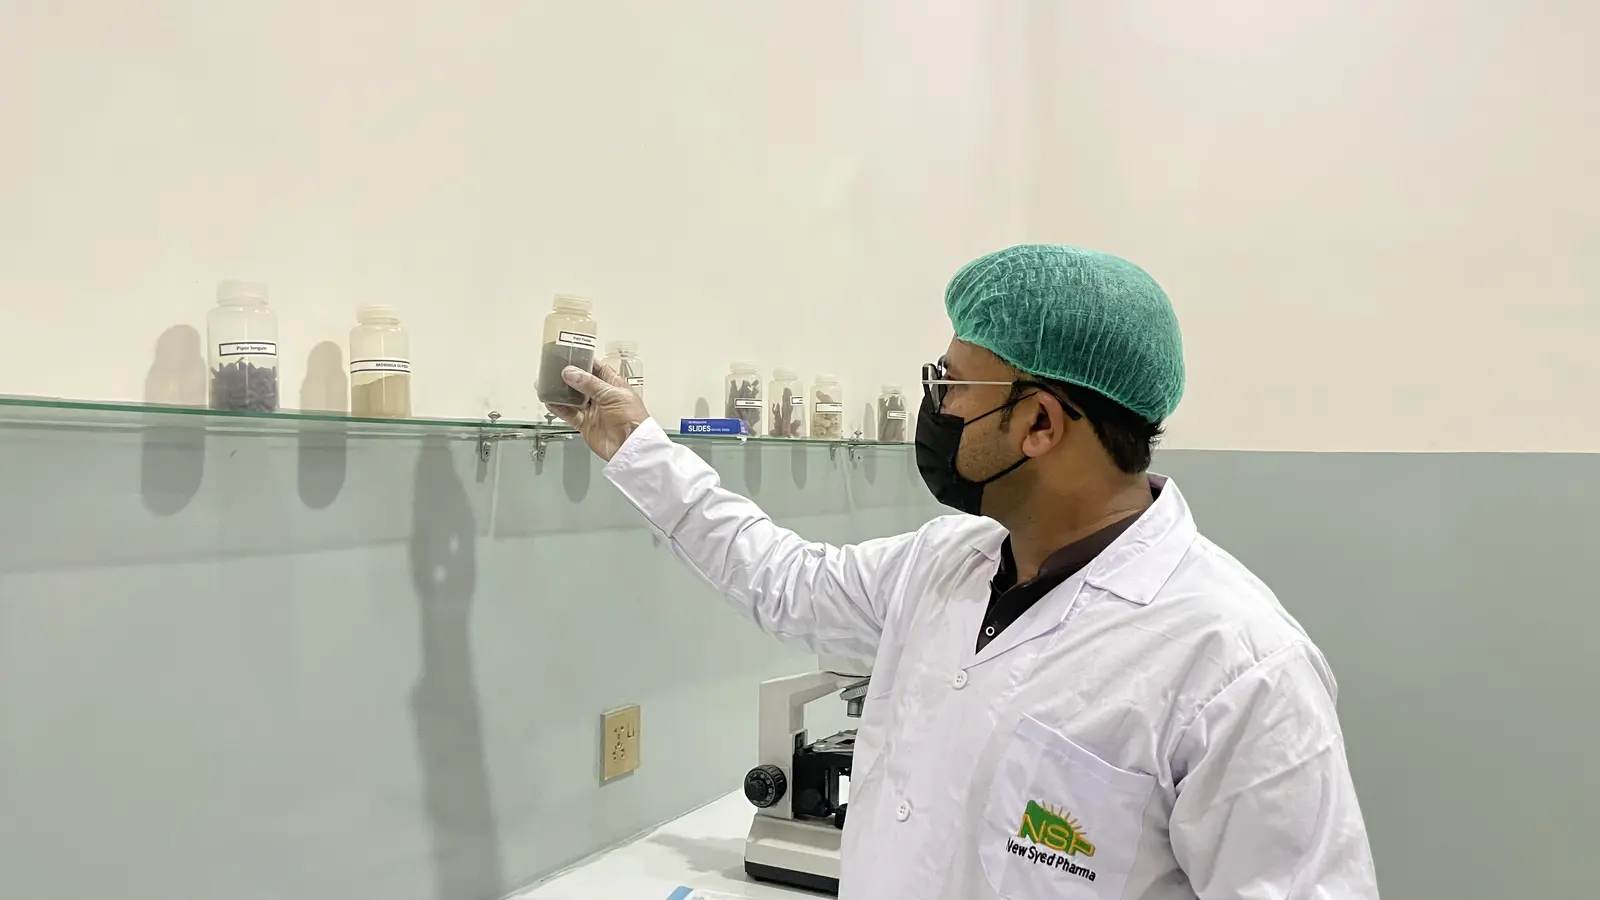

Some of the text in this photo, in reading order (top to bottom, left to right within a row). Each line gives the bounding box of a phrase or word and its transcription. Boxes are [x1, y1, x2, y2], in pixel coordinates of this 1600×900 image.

[688, 424, 711, 432] SLIDES
[1017, 813, 1096, 857] NSP
[1027, 845, 1056, 866] Syed
[1055, 856, 1096, 882] Pharma
